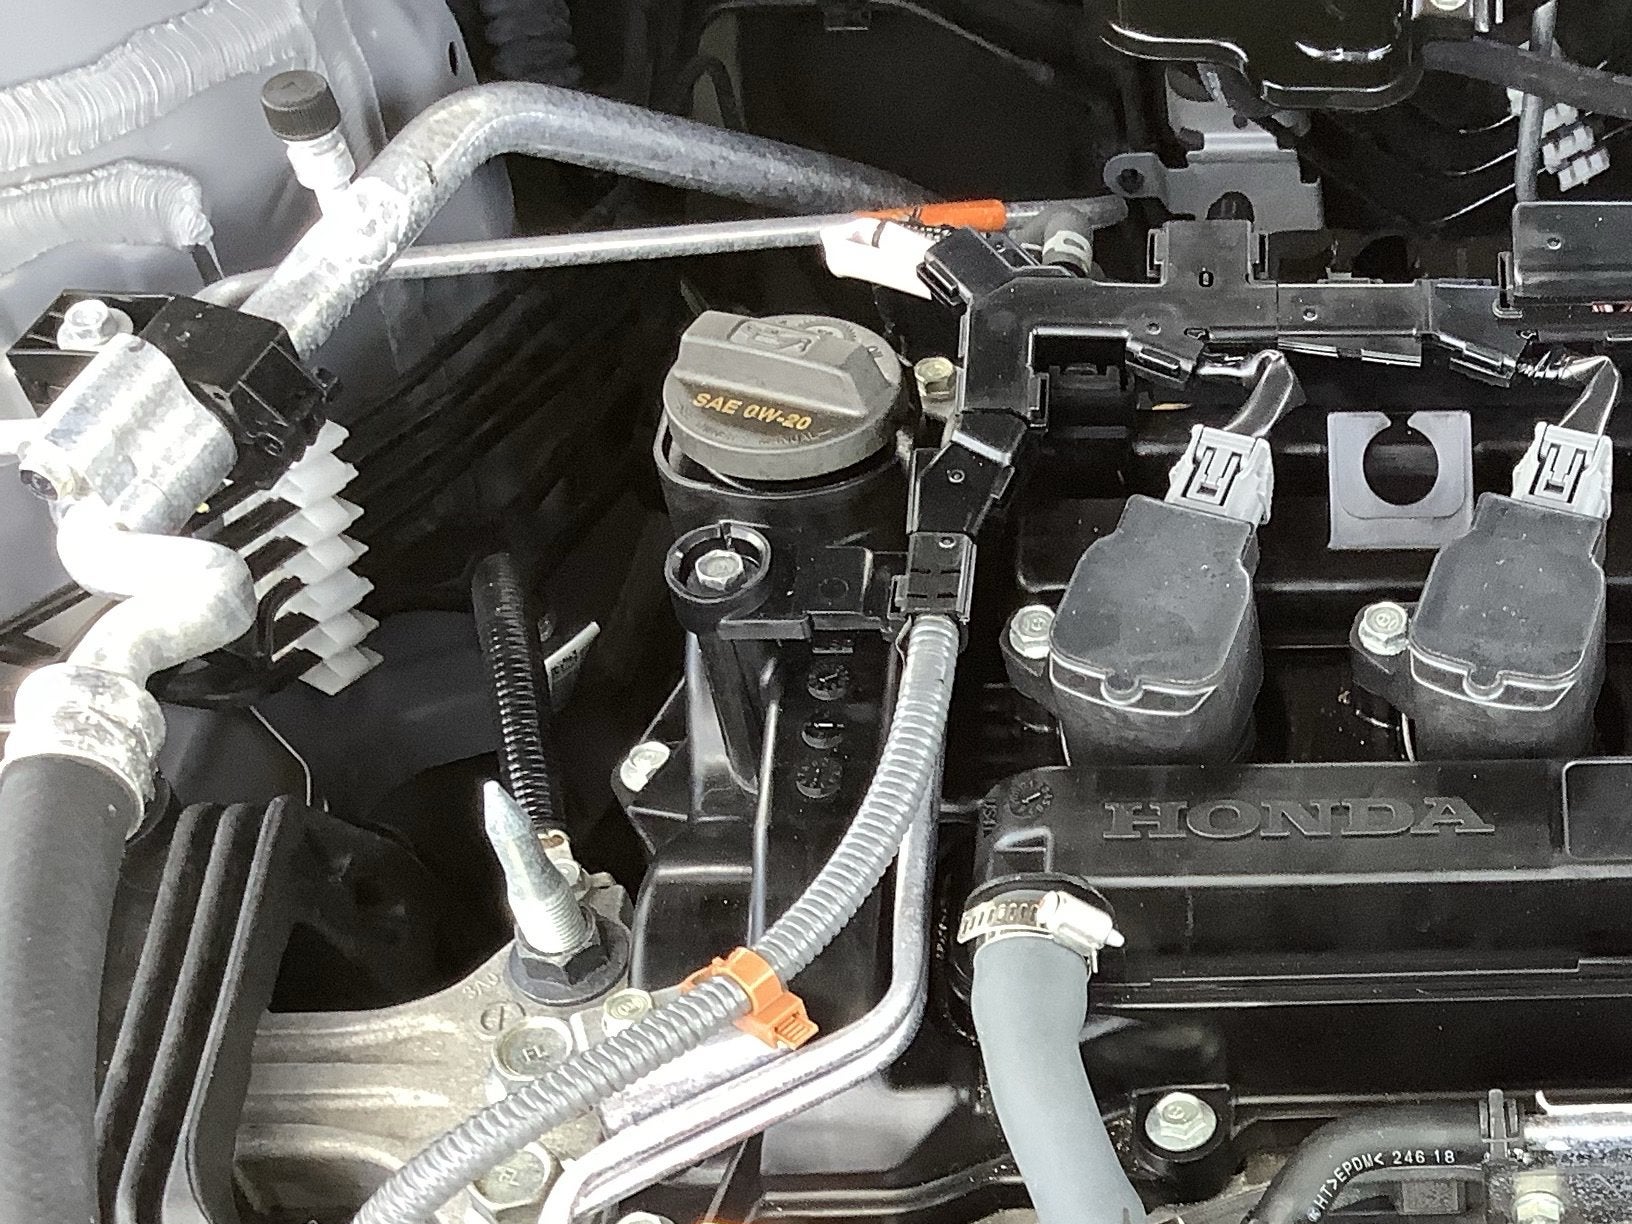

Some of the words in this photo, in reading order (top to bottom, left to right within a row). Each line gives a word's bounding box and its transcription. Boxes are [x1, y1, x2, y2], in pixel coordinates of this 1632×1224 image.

[691, 392, 742, 414] SAE
[743, 403, 813, 431] 0W-20
[1103, 795, 1496, 841] HONDA
[1391, 1149, 1426, 1165] 246
[1433, 1148, 1456, 1164] 18
